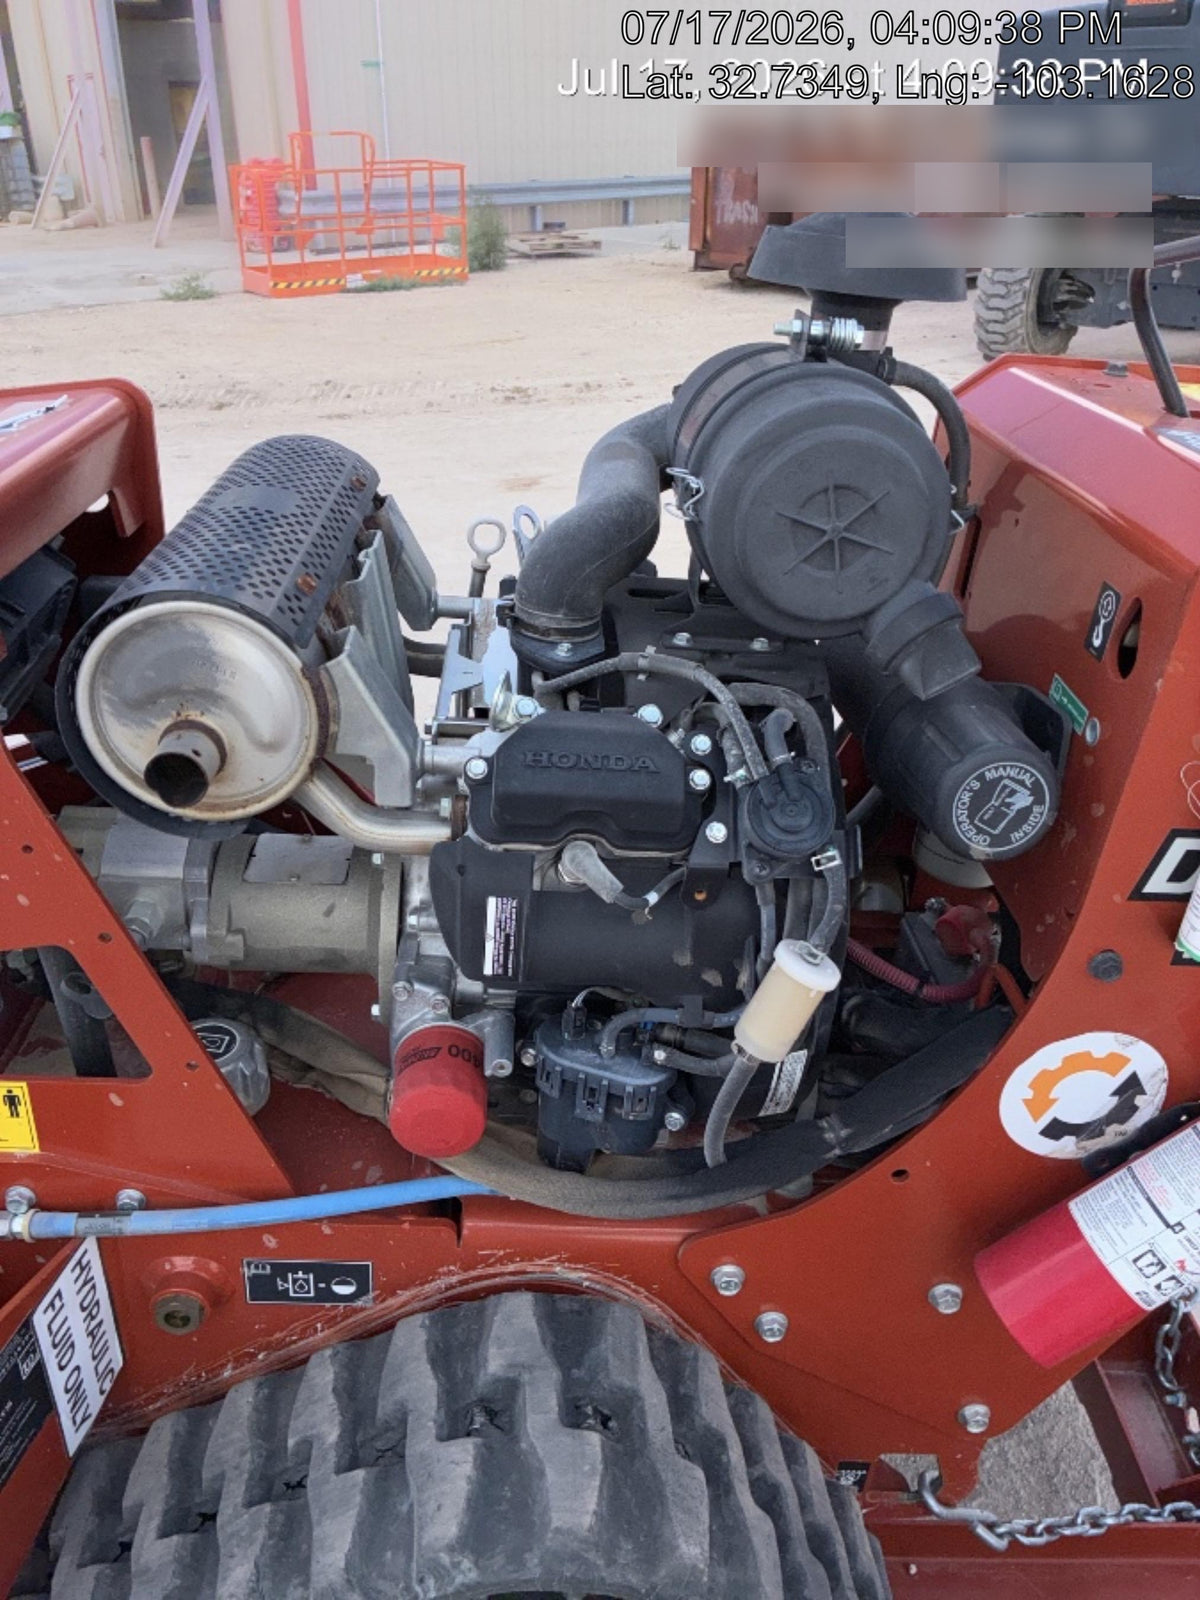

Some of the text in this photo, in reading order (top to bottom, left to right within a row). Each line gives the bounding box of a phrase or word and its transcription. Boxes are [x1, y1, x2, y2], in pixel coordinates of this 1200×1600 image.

[522, 749, 661, 774] HONDA
[957, 766, 1036, 846] OPERATOR'S MANUAL
[1009, 804, 1045, 844] INSIDE
[43, 1288, 93, 1434] FLUID ONLY
[70, 1248, 115, 1397] HYDRAULIC
